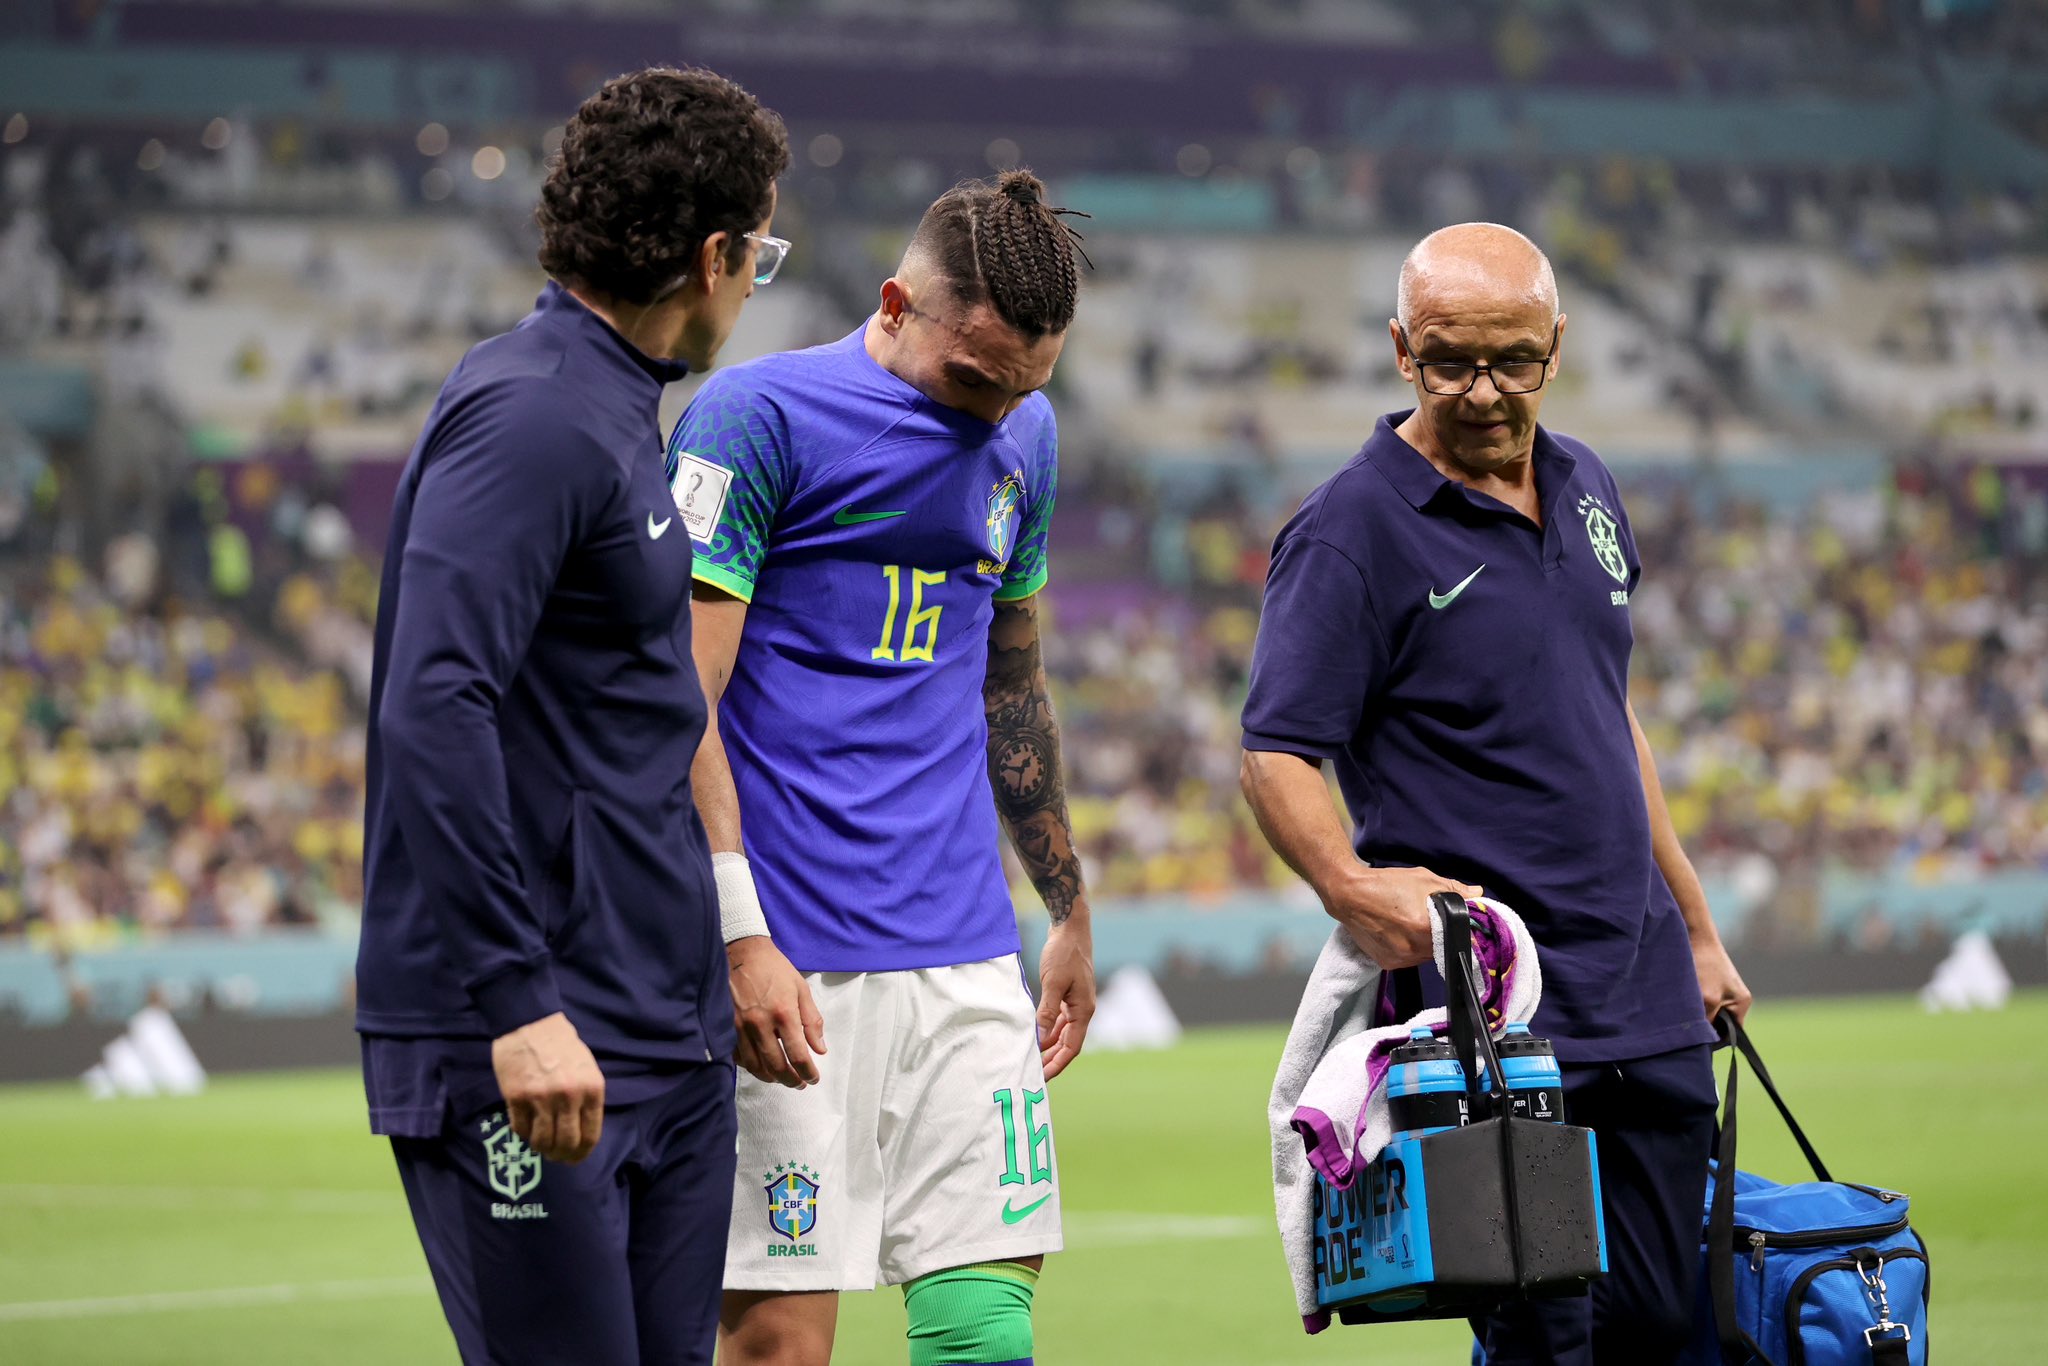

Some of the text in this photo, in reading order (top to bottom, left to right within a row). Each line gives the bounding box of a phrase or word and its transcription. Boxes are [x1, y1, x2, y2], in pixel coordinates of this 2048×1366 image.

[872, 565, 946, 662] 16
[993, 1088, 1052, 1186] 16
[491, 1203, 549, 1219] BRASIL
[784, 1200, 803, 1208] CBF
[767, 1244, 818, 1256] BRASIL
